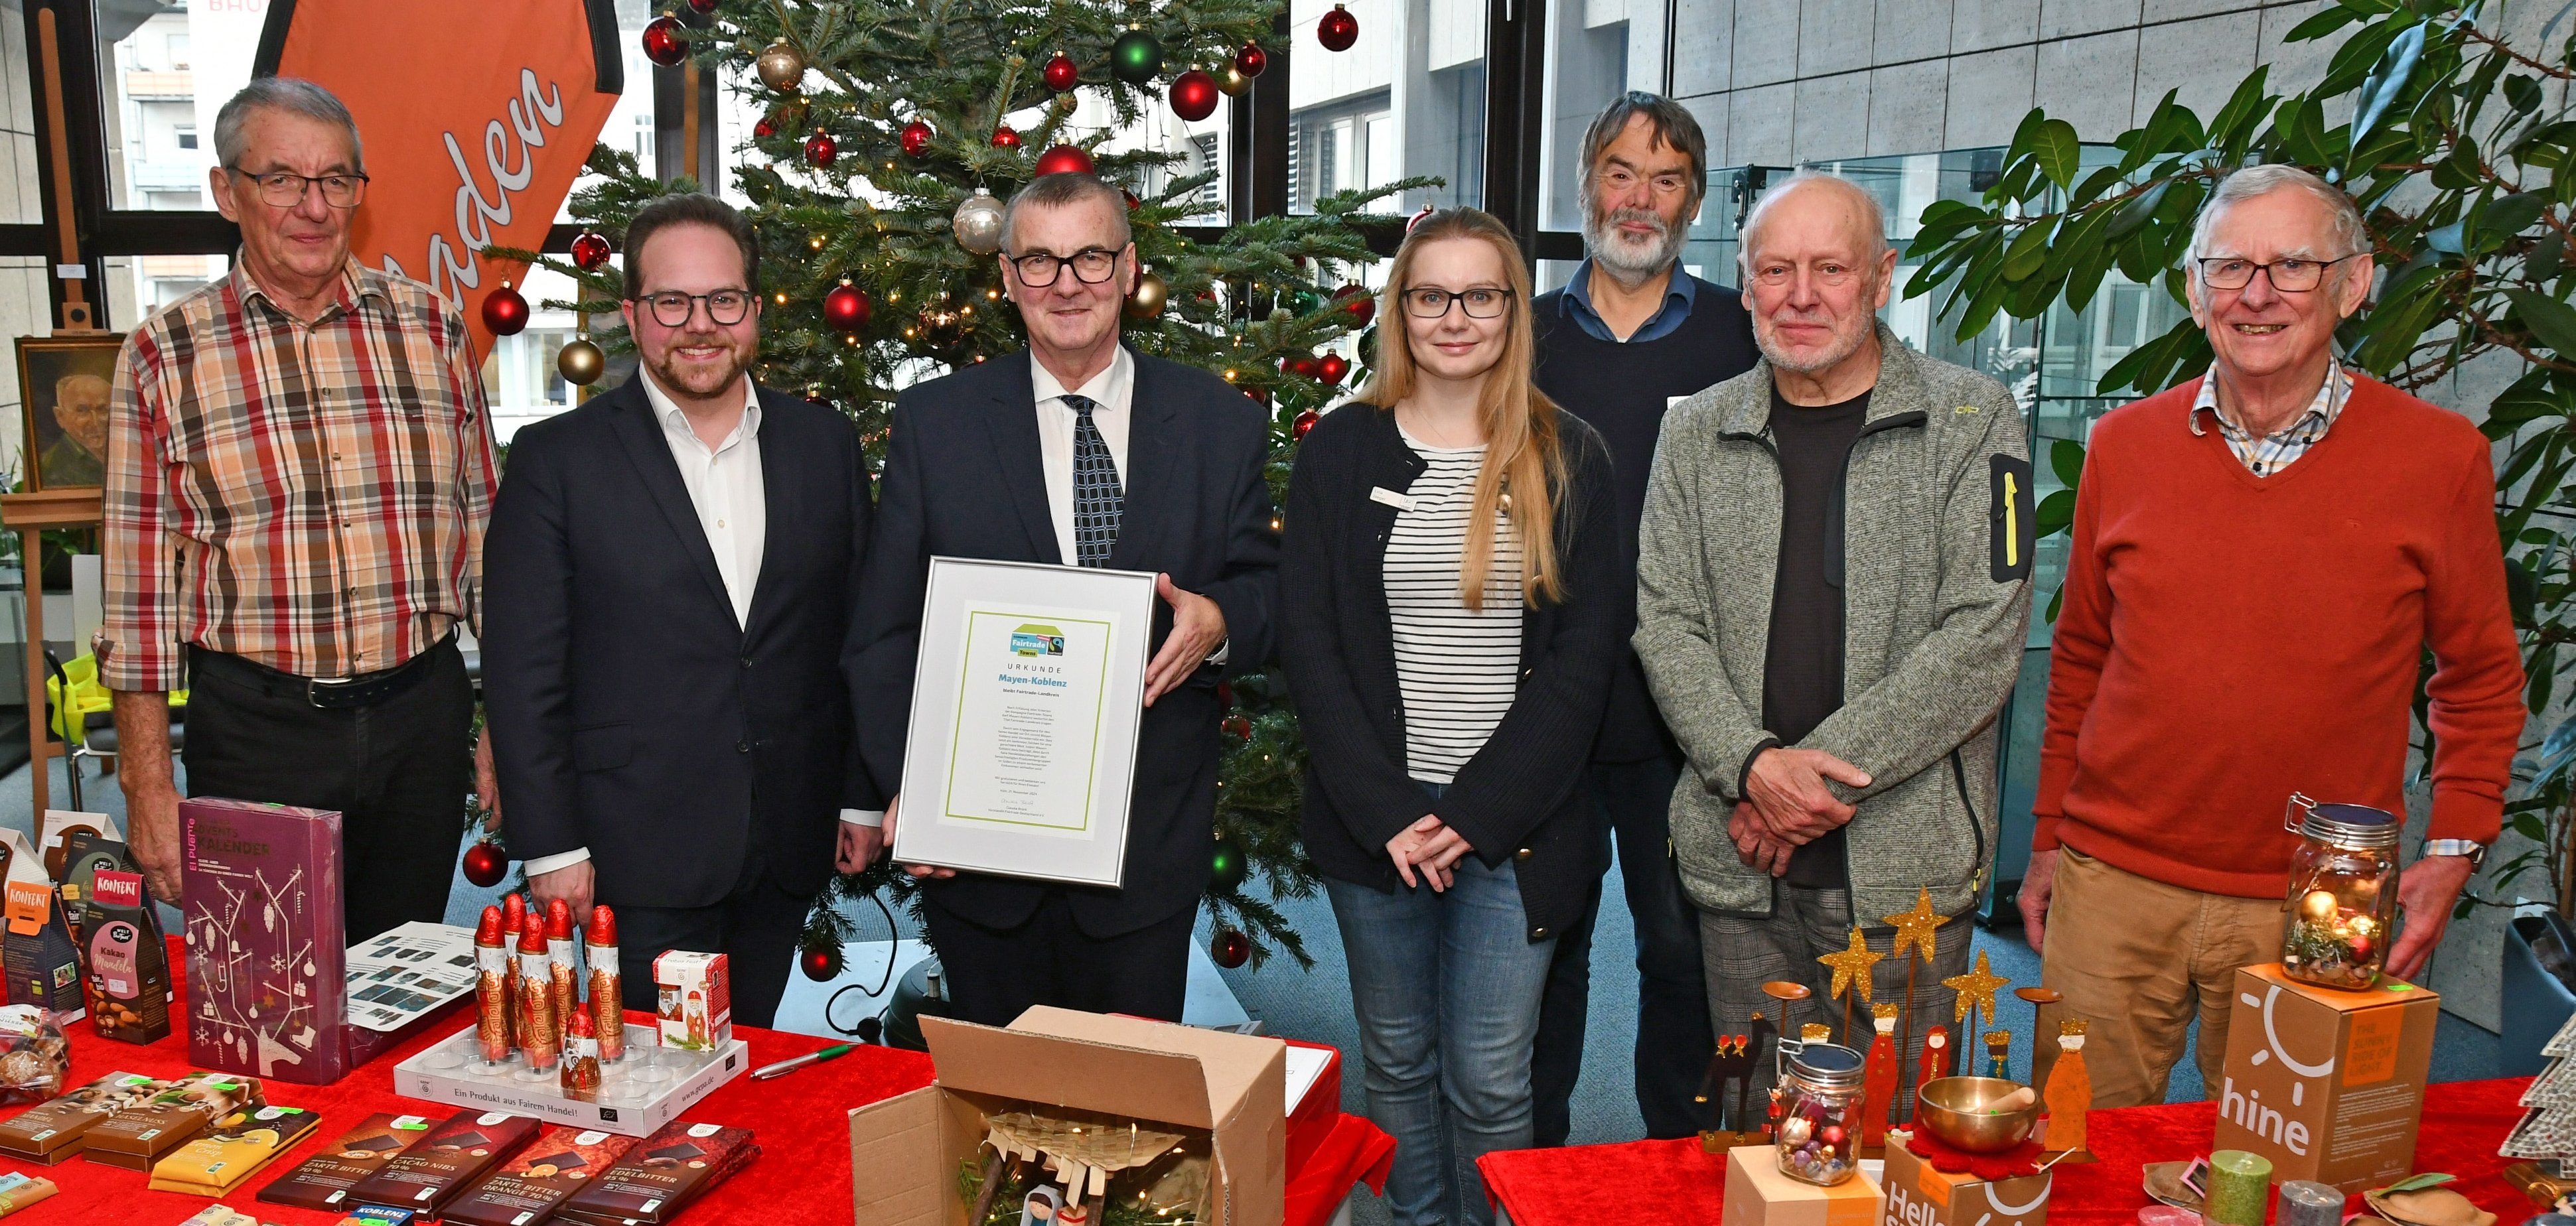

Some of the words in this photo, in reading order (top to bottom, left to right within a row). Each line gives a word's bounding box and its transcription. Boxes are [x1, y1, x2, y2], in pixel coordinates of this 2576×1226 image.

[383, 68, 563, 312] aden
[1012, 640, 1046, 648] Fairtrade
[1007, 663, 1062, 673] URKUNDE
[999, 673, 1068, 687] Mayen-Koblenz
[97, 876, 138, 896] KONFEKT
[9, 888, 47, 908] KONFEKT
[100, 947, 125, 958] Kakao
[94, 953, 133, 973] Mandeln
[681, 1076, 714, 1102] www.gepa.de
[454, 1088, 467, 1098] Ein
[469, 1091, 501, 1103] Produkt
[503, 1097, 516, 1106] aus
[518, 1099, 545, 1111] Fairem
[547, 1105, 578, 1117] Handel!
[115, 1114, 168, 1125] HASELNUSS
[2221, 1076, 2309, 1156] hine
[188, 1140, 224, 1150] Lemon
[196, 1148, 224, 1156] Crisp
[304, 1162, 339, 1170] ZARTE
[429, 1162, 458, 1172] NIBS
[609, 1170, 678, 1184] EDELBITTER
[482, 1184, 528, 1196] ORANGE
[488, 1179, 524, 1190] ZARTE
[524, 1184, 562, 1197] BITTER
[357, 1207, 407, 1218] KOBLENZ
